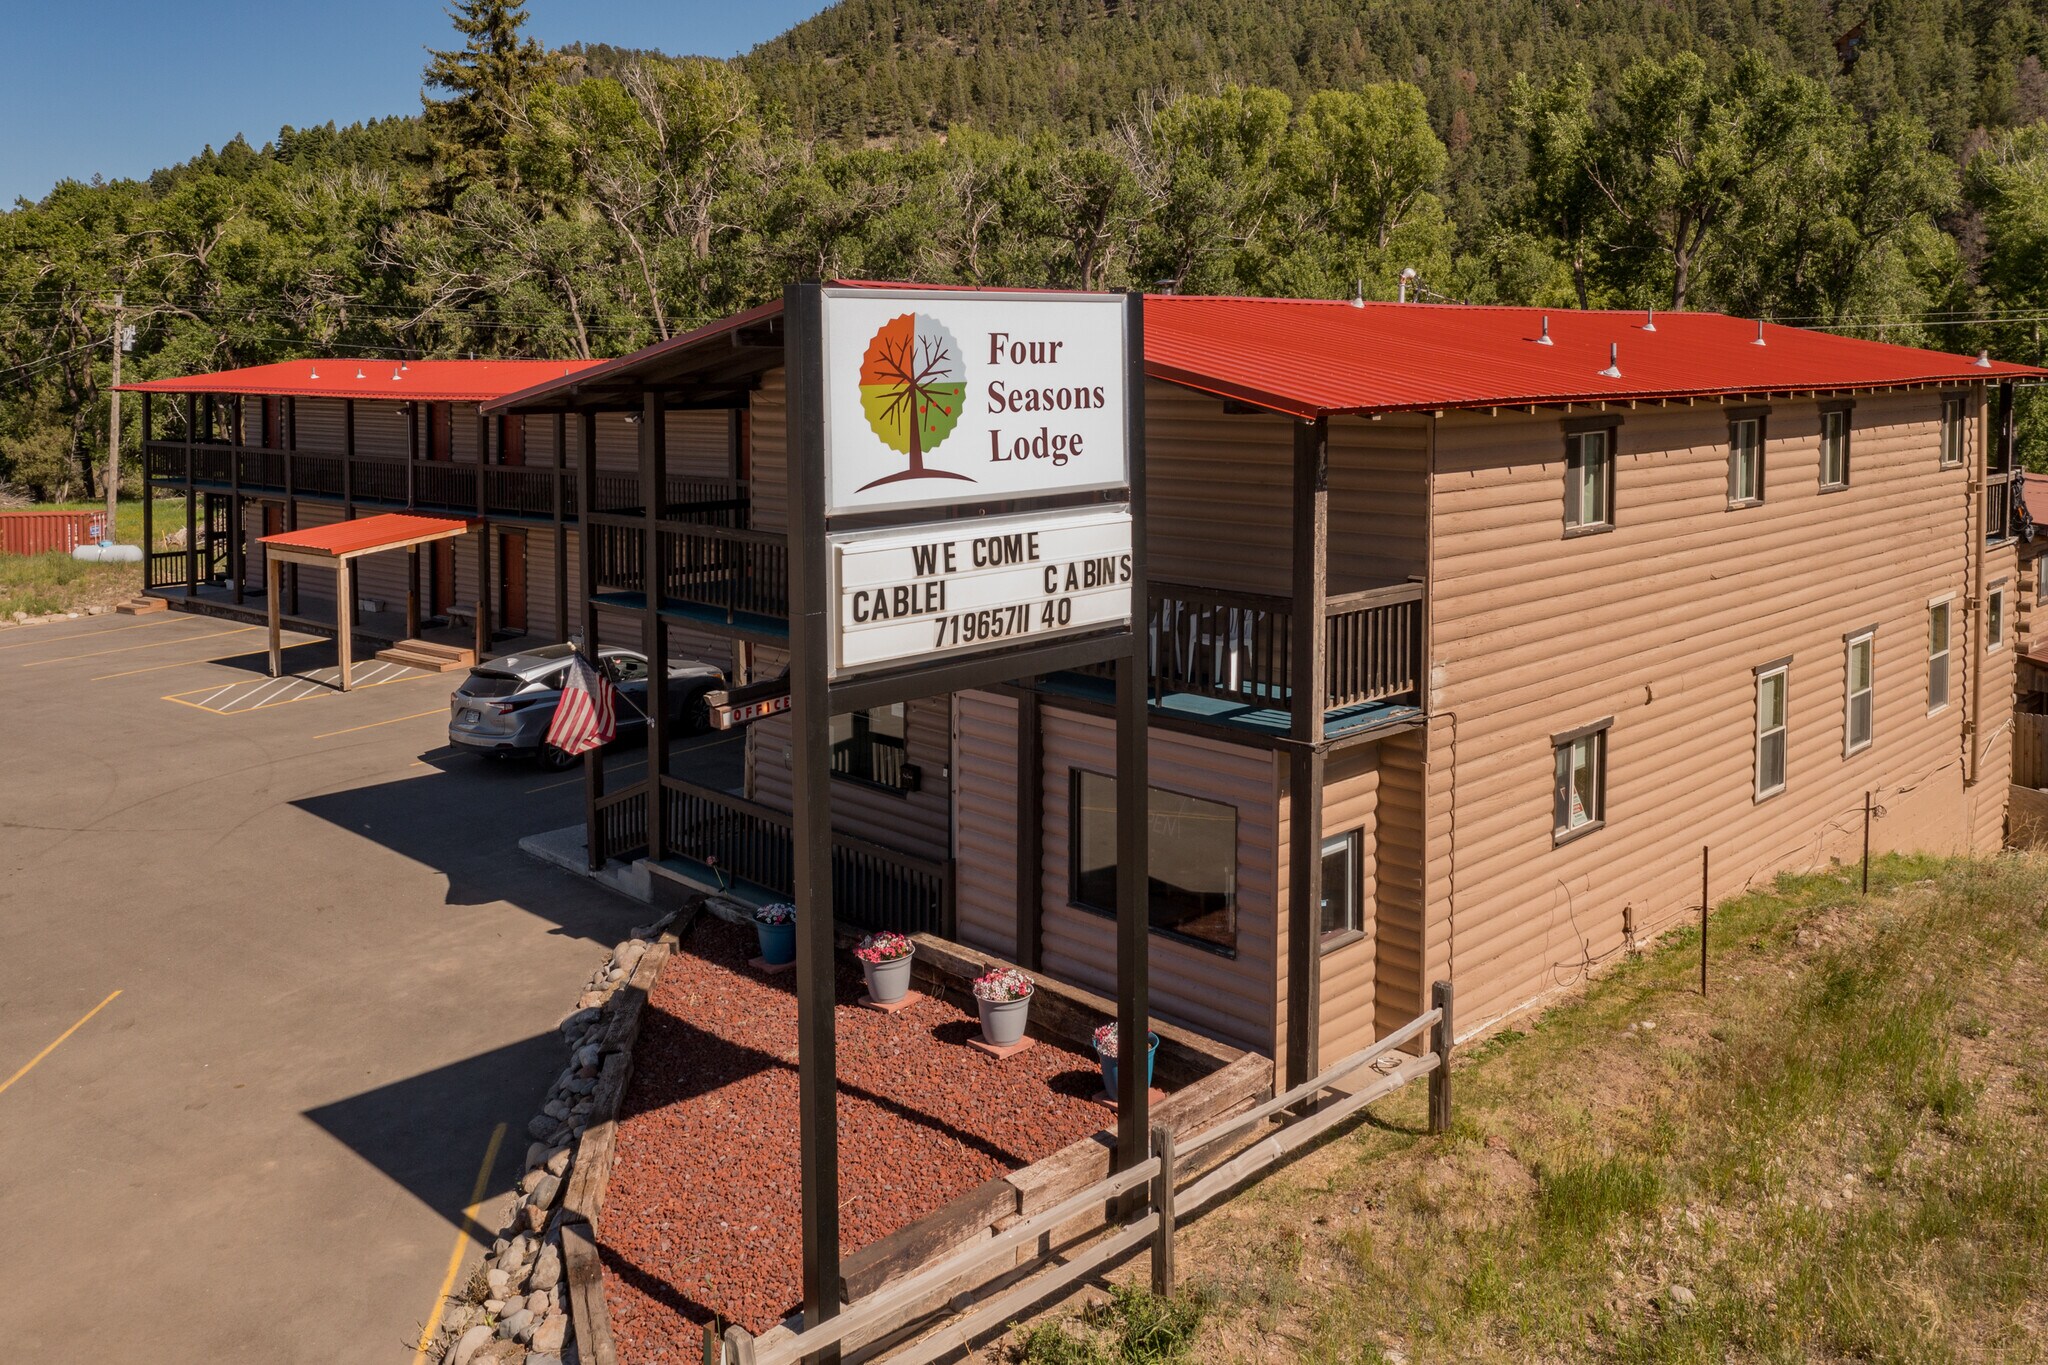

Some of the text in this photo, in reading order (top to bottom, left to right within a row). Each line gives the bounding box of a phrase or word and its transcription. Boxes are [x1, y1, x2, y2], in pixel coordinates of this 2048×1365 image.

[987, 332, 1063, 365] Four
[987, 380, 1105, 414] Seasons
[989, 427, 1084, 467] Lodge
[1041, 596, 1072, 629] 40
[733, 696, 790, 721] OFFICE
